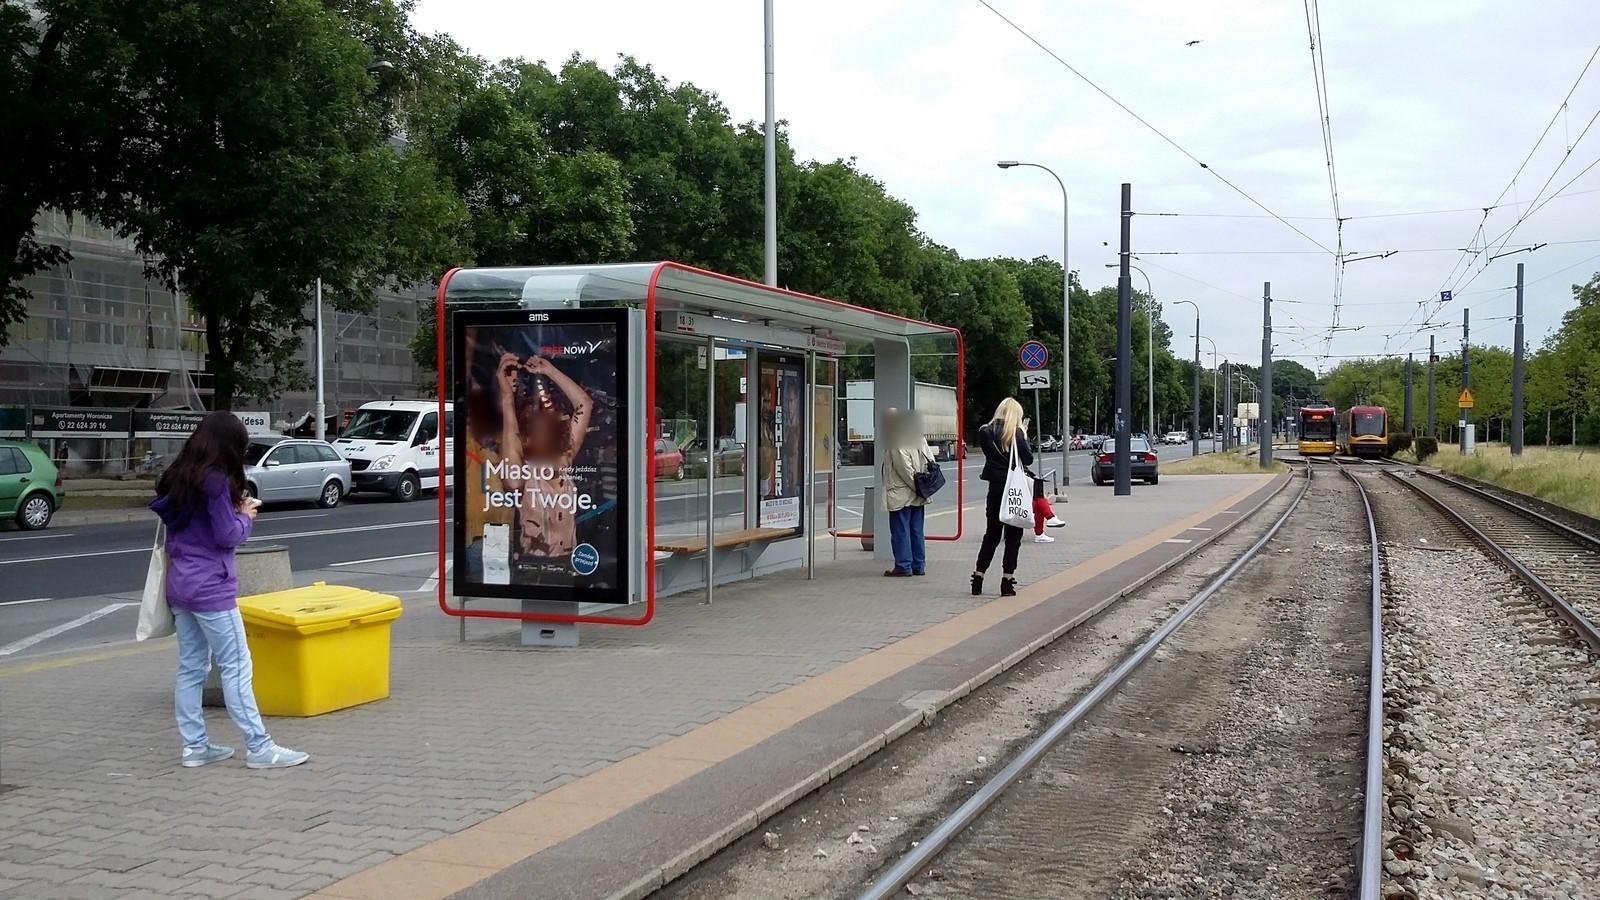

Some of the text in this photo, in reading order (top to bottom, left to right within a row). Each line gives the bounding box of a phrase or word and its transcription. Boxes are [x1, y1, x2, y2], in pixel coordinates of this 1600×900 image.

[528, 313, 549, 321] ams
[67, 421, 75, 429] 22
[76, 421, 88, 429] 624
[241, 416, 264, 426] ldesa
[163, 422, 170, 430] 22
[774, 369, 783, 496] FIGHTER
[485, 458, 554, 480] Miasto
[1008, 488, 1023, 497] GLA
[483, 484, 597, 514] jest Twoje.
[1008, 497, 1022, 506] MO
[1009, 506, 1028, 518] ROUS
